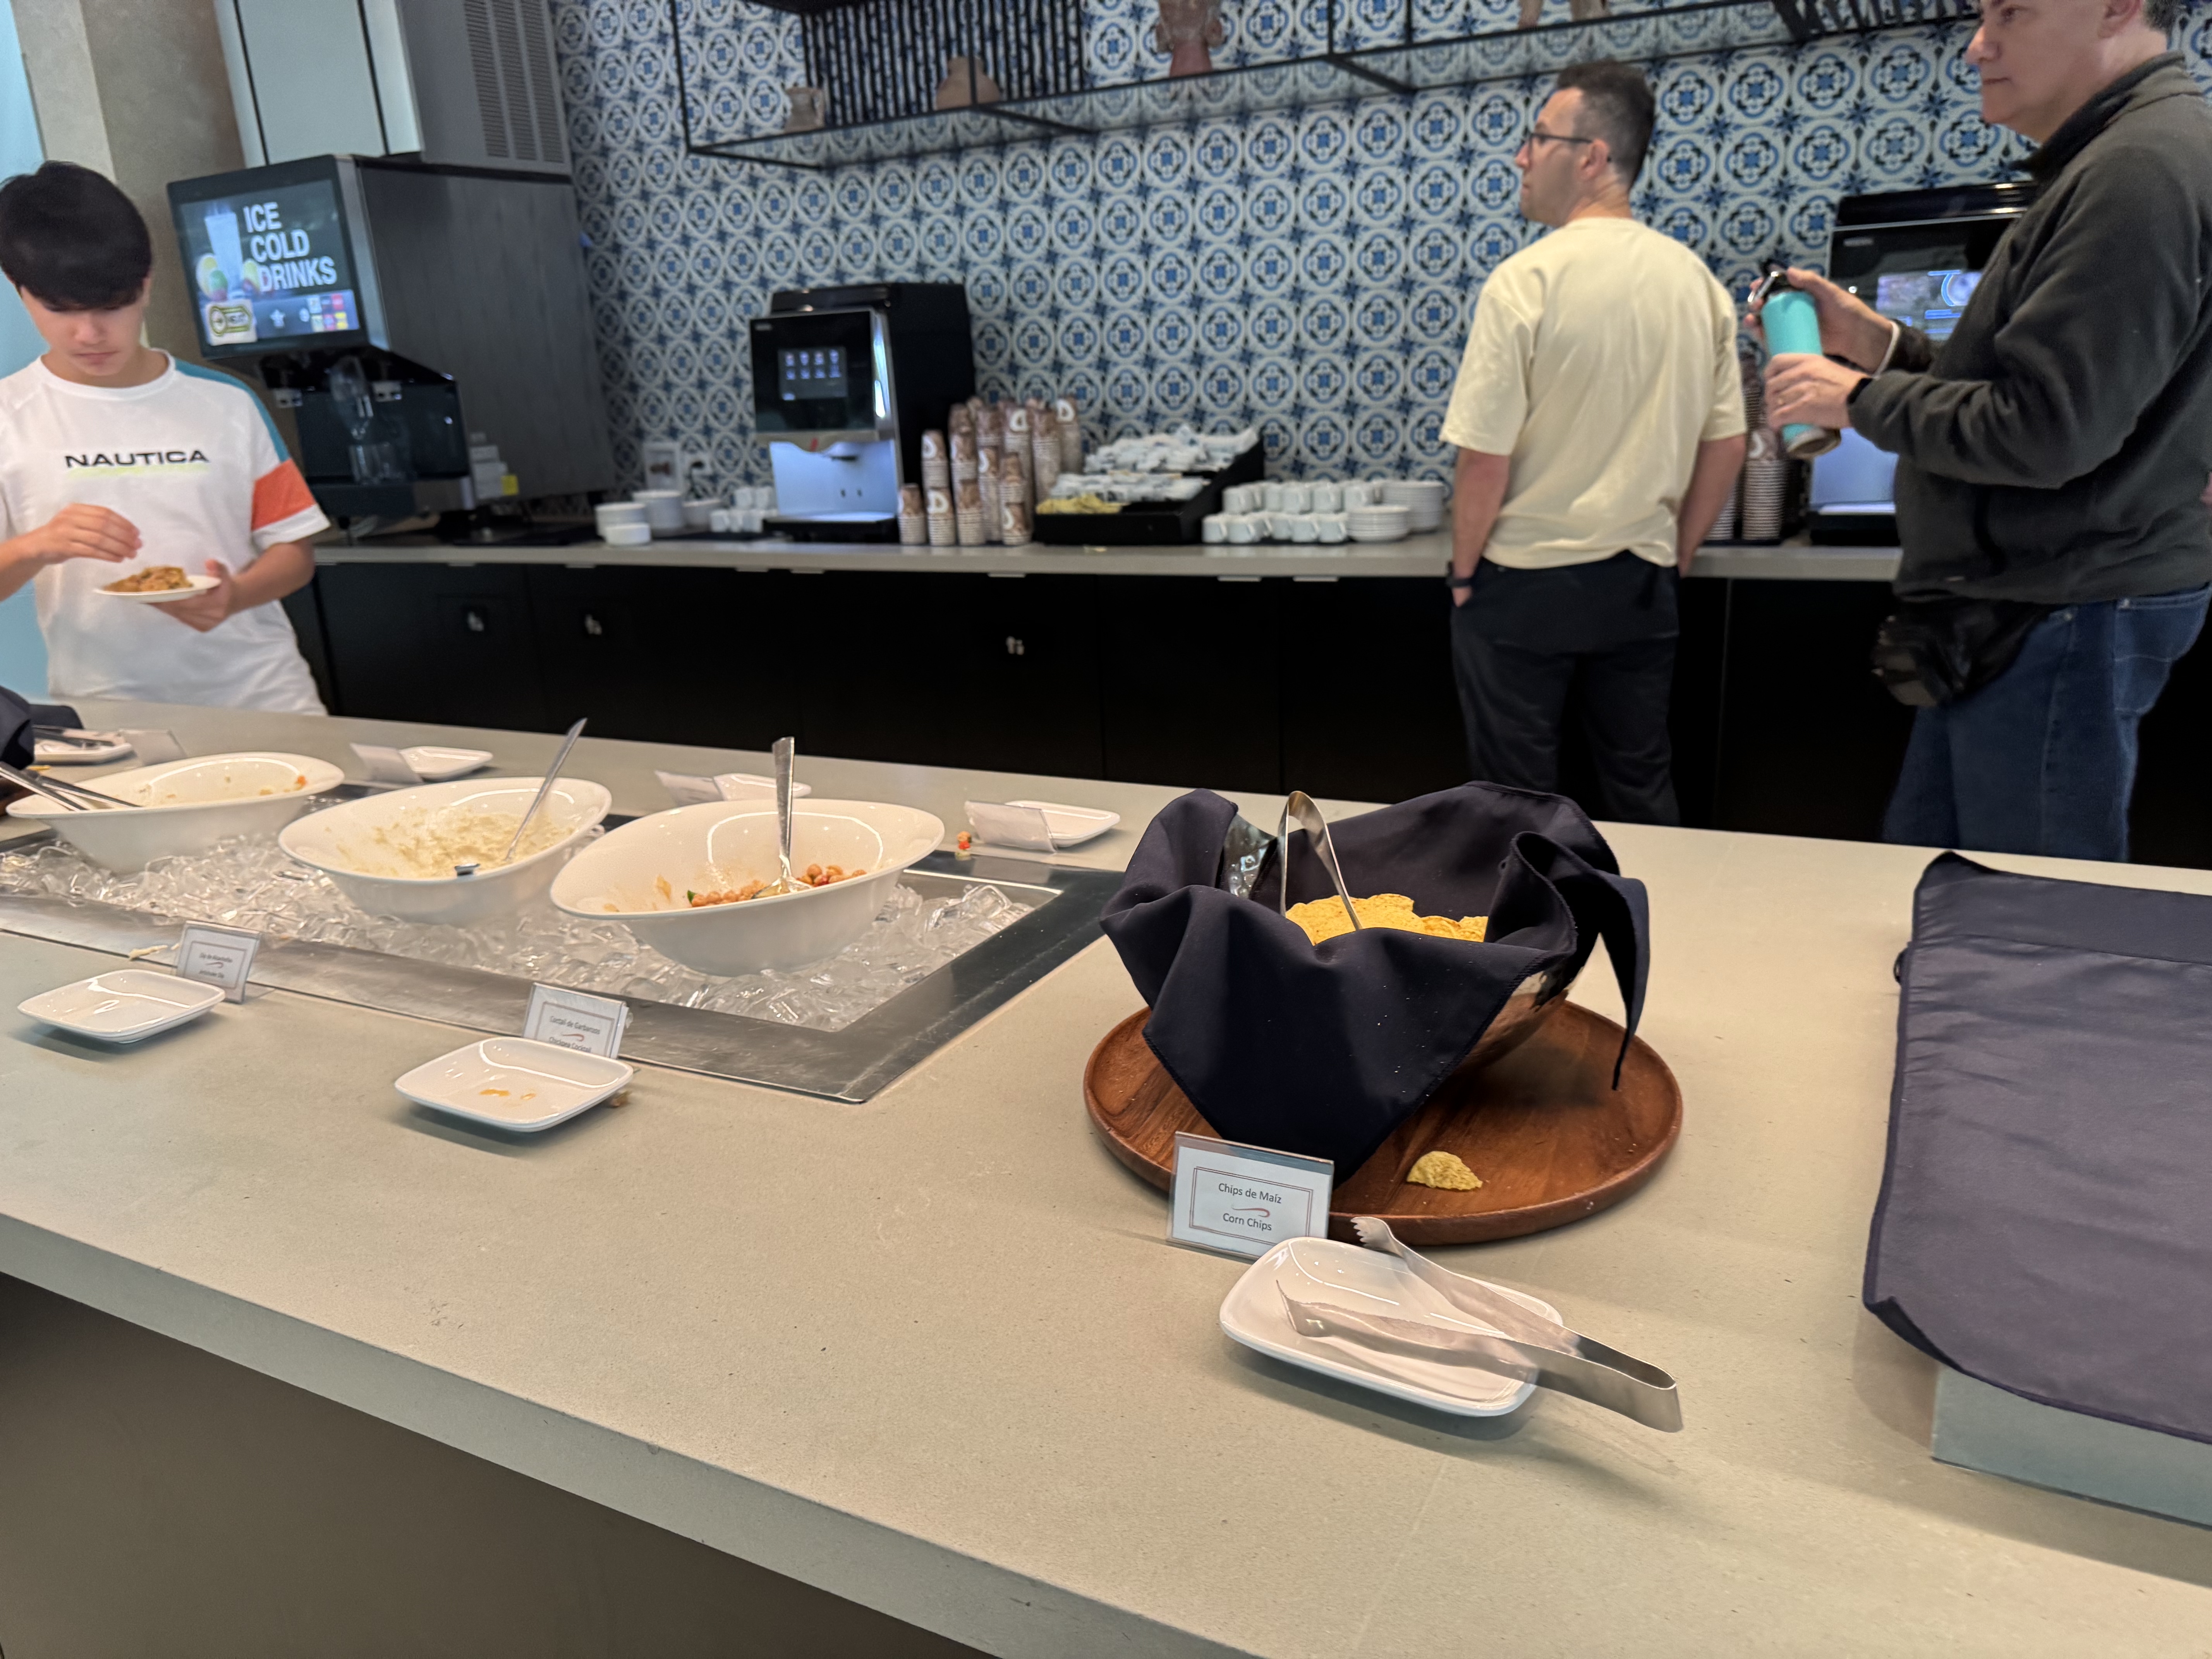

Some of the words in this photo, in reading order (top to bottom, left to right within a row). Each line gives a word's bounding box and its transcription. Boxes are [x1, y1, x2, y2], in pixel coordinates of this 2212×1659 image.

[243, 202, 282, 233] ICE
[251, 229, 310, 263] COLD
[258, 256, 337, 292] DRINKS
[65, 450, 210, 468] NAUTICA
[1219, 1183, 1242, 1195] Chips
[1245, 1188, 1257, 1199] de
[1259, 1191, 1282, 1204] Maíz
[1223, 1213, 1244, 1225] Corn
[1247, 1218, 1272, 1231] Chips
